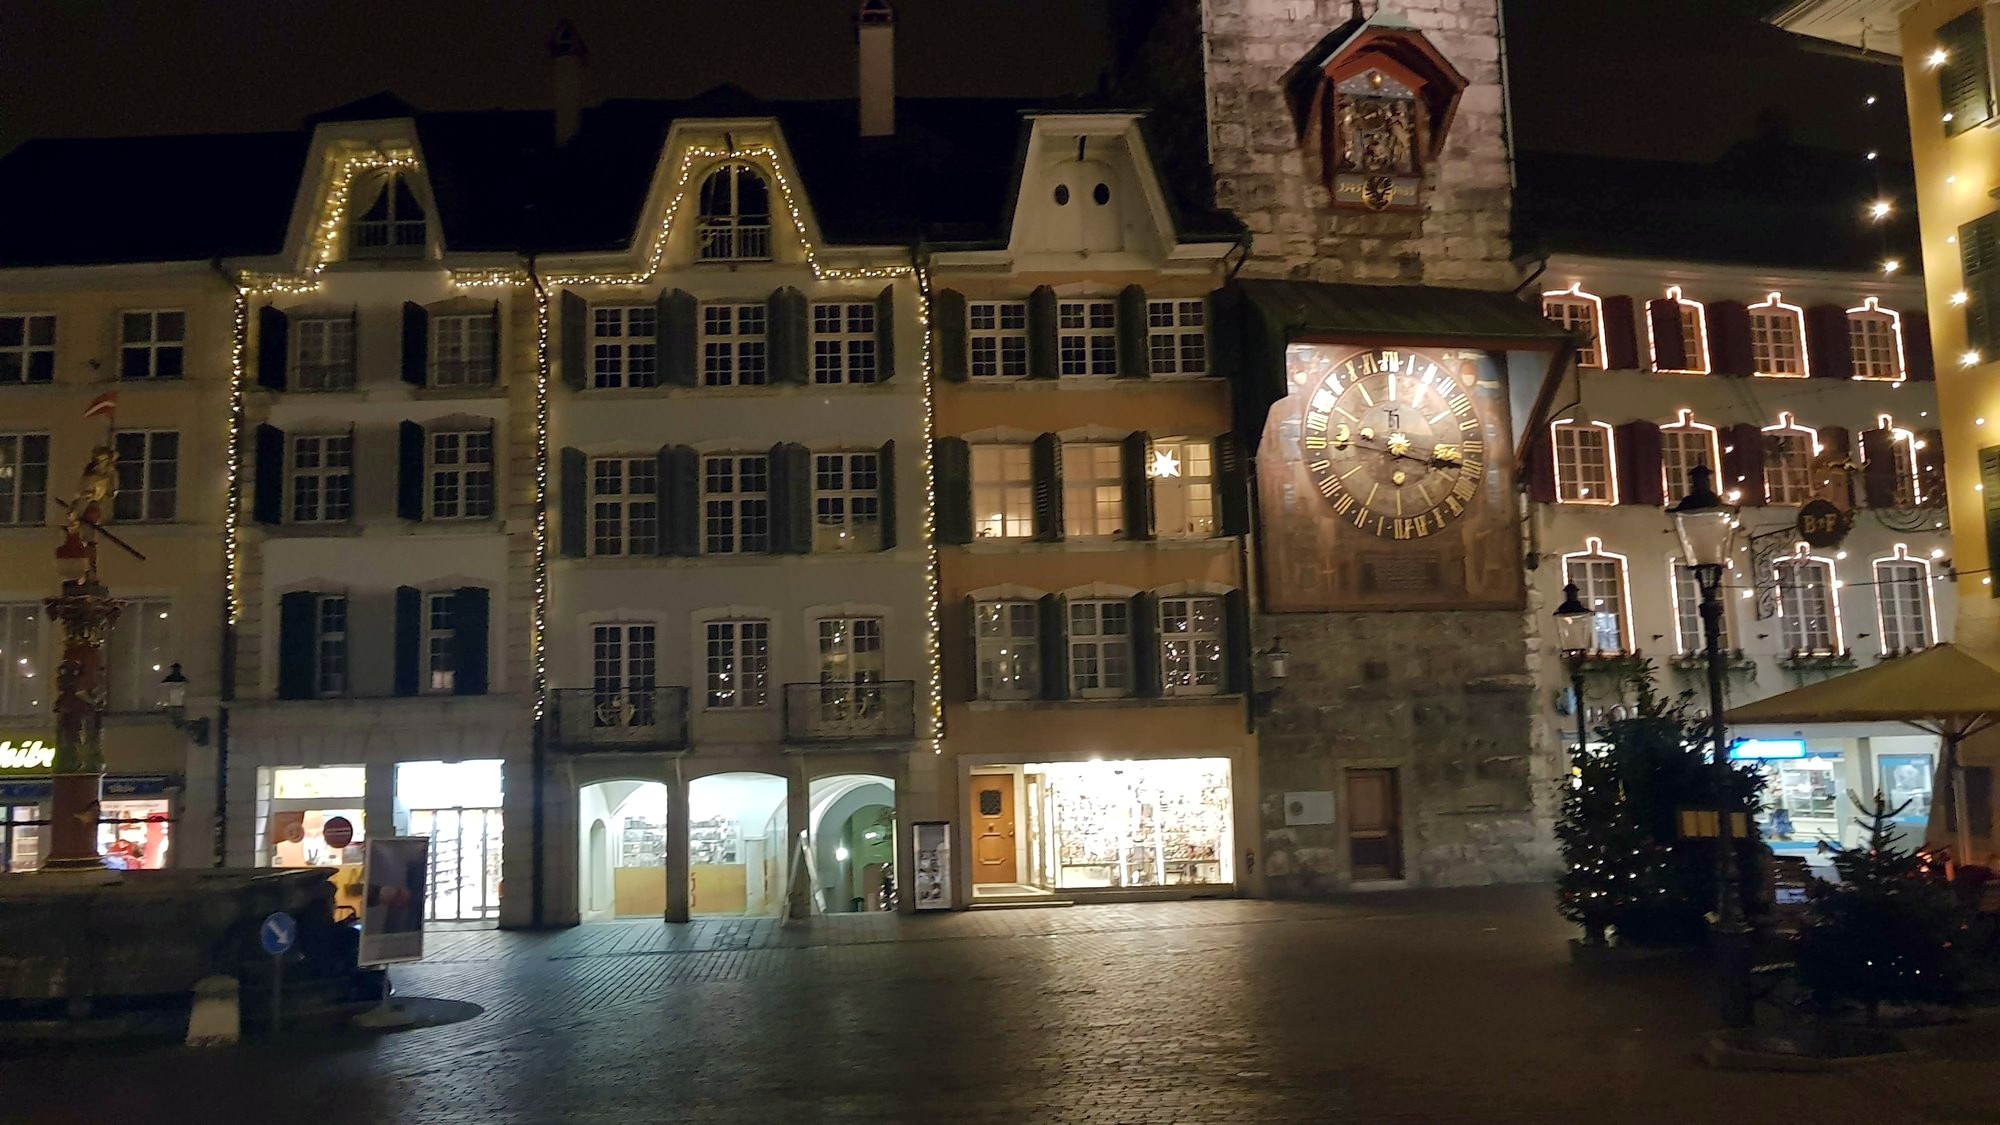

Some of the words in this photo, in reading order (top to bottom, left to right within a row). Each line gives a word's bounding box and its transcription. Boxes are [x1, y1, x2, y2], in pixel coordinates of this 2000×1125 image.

[1436, 376, 1456, 398] III
[1450, 393, 1472, 416] IIII
[1318, 474, 1342, 497] IIII
[1333, 493, 1355, 515] III
